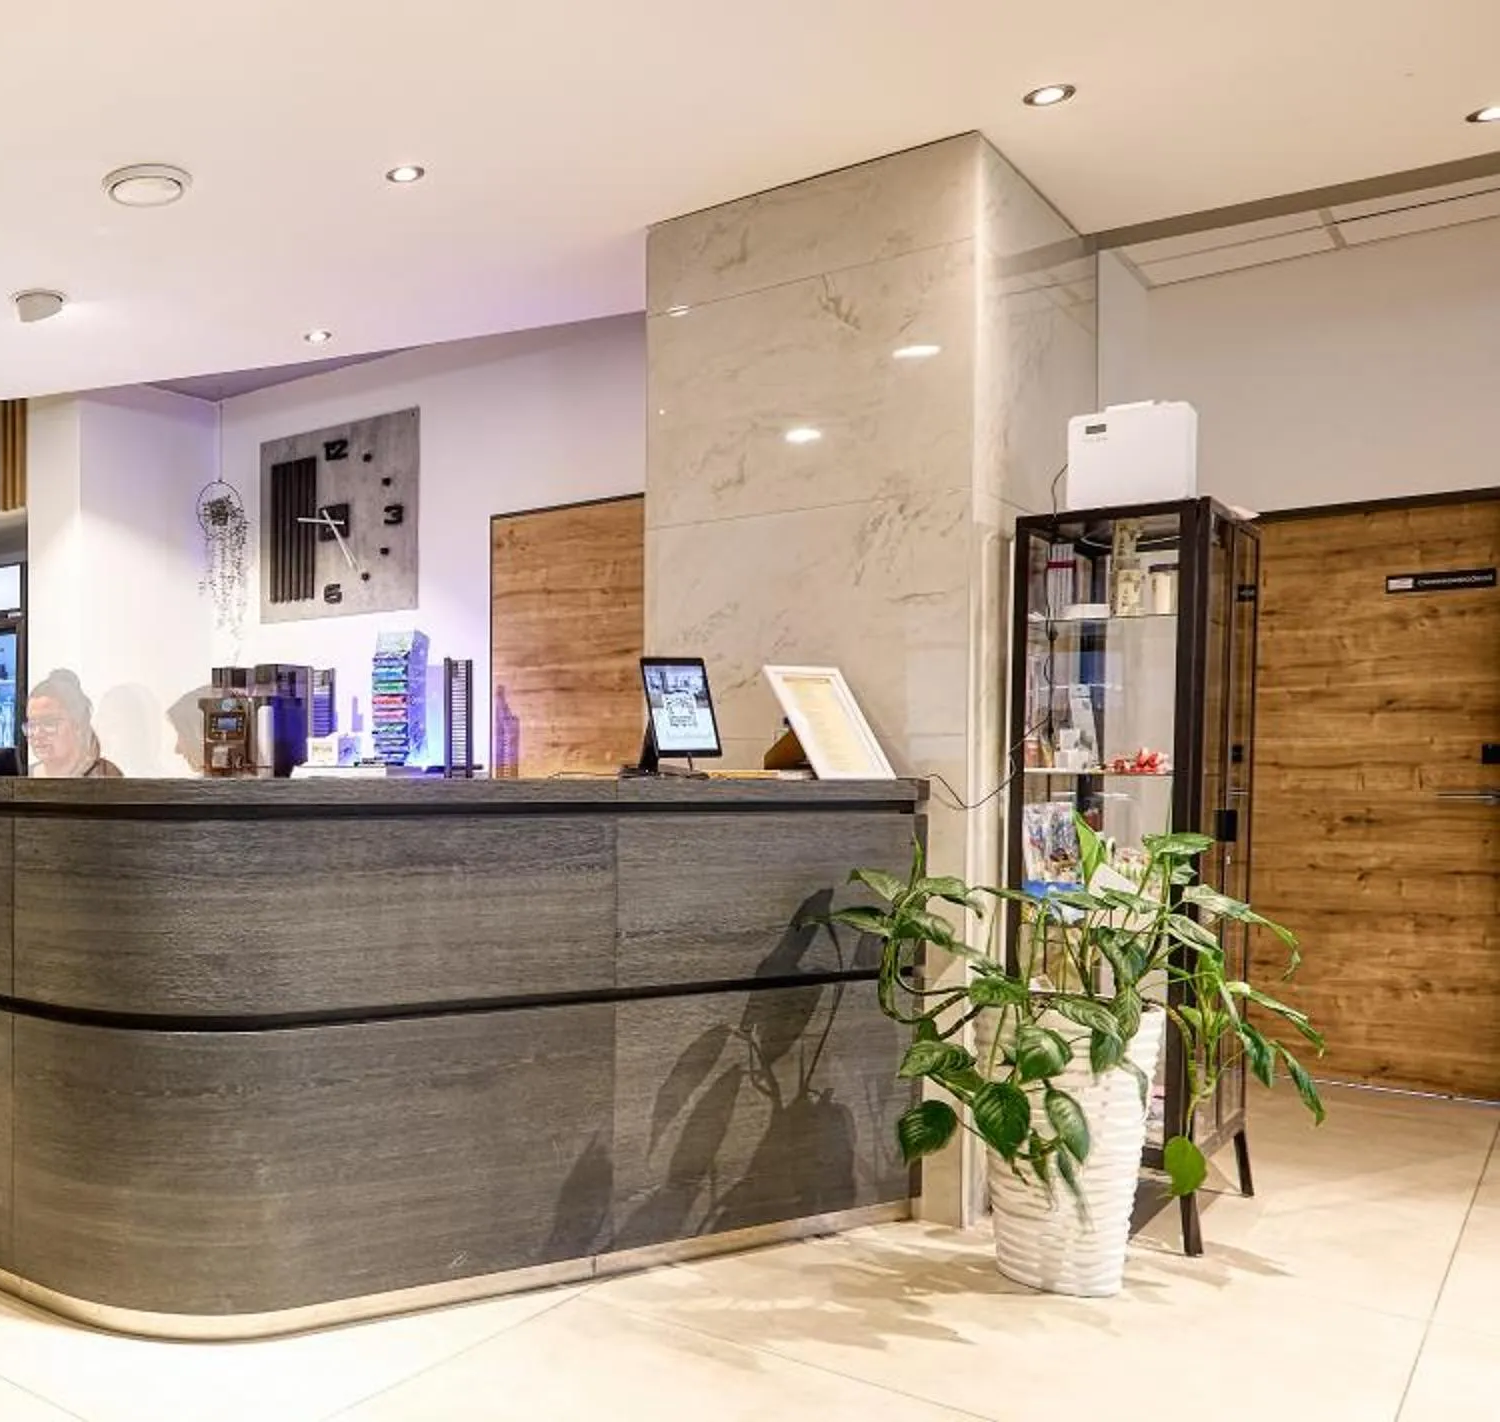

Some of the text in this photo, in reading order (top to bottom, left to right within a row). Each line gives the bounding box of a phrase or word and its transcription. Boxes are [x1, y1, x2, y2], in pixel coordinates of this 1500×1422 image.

[323, 439, 349, 461] 12
[383, 504, 404, 525] 3
[323, 583, 343, 604] 6
